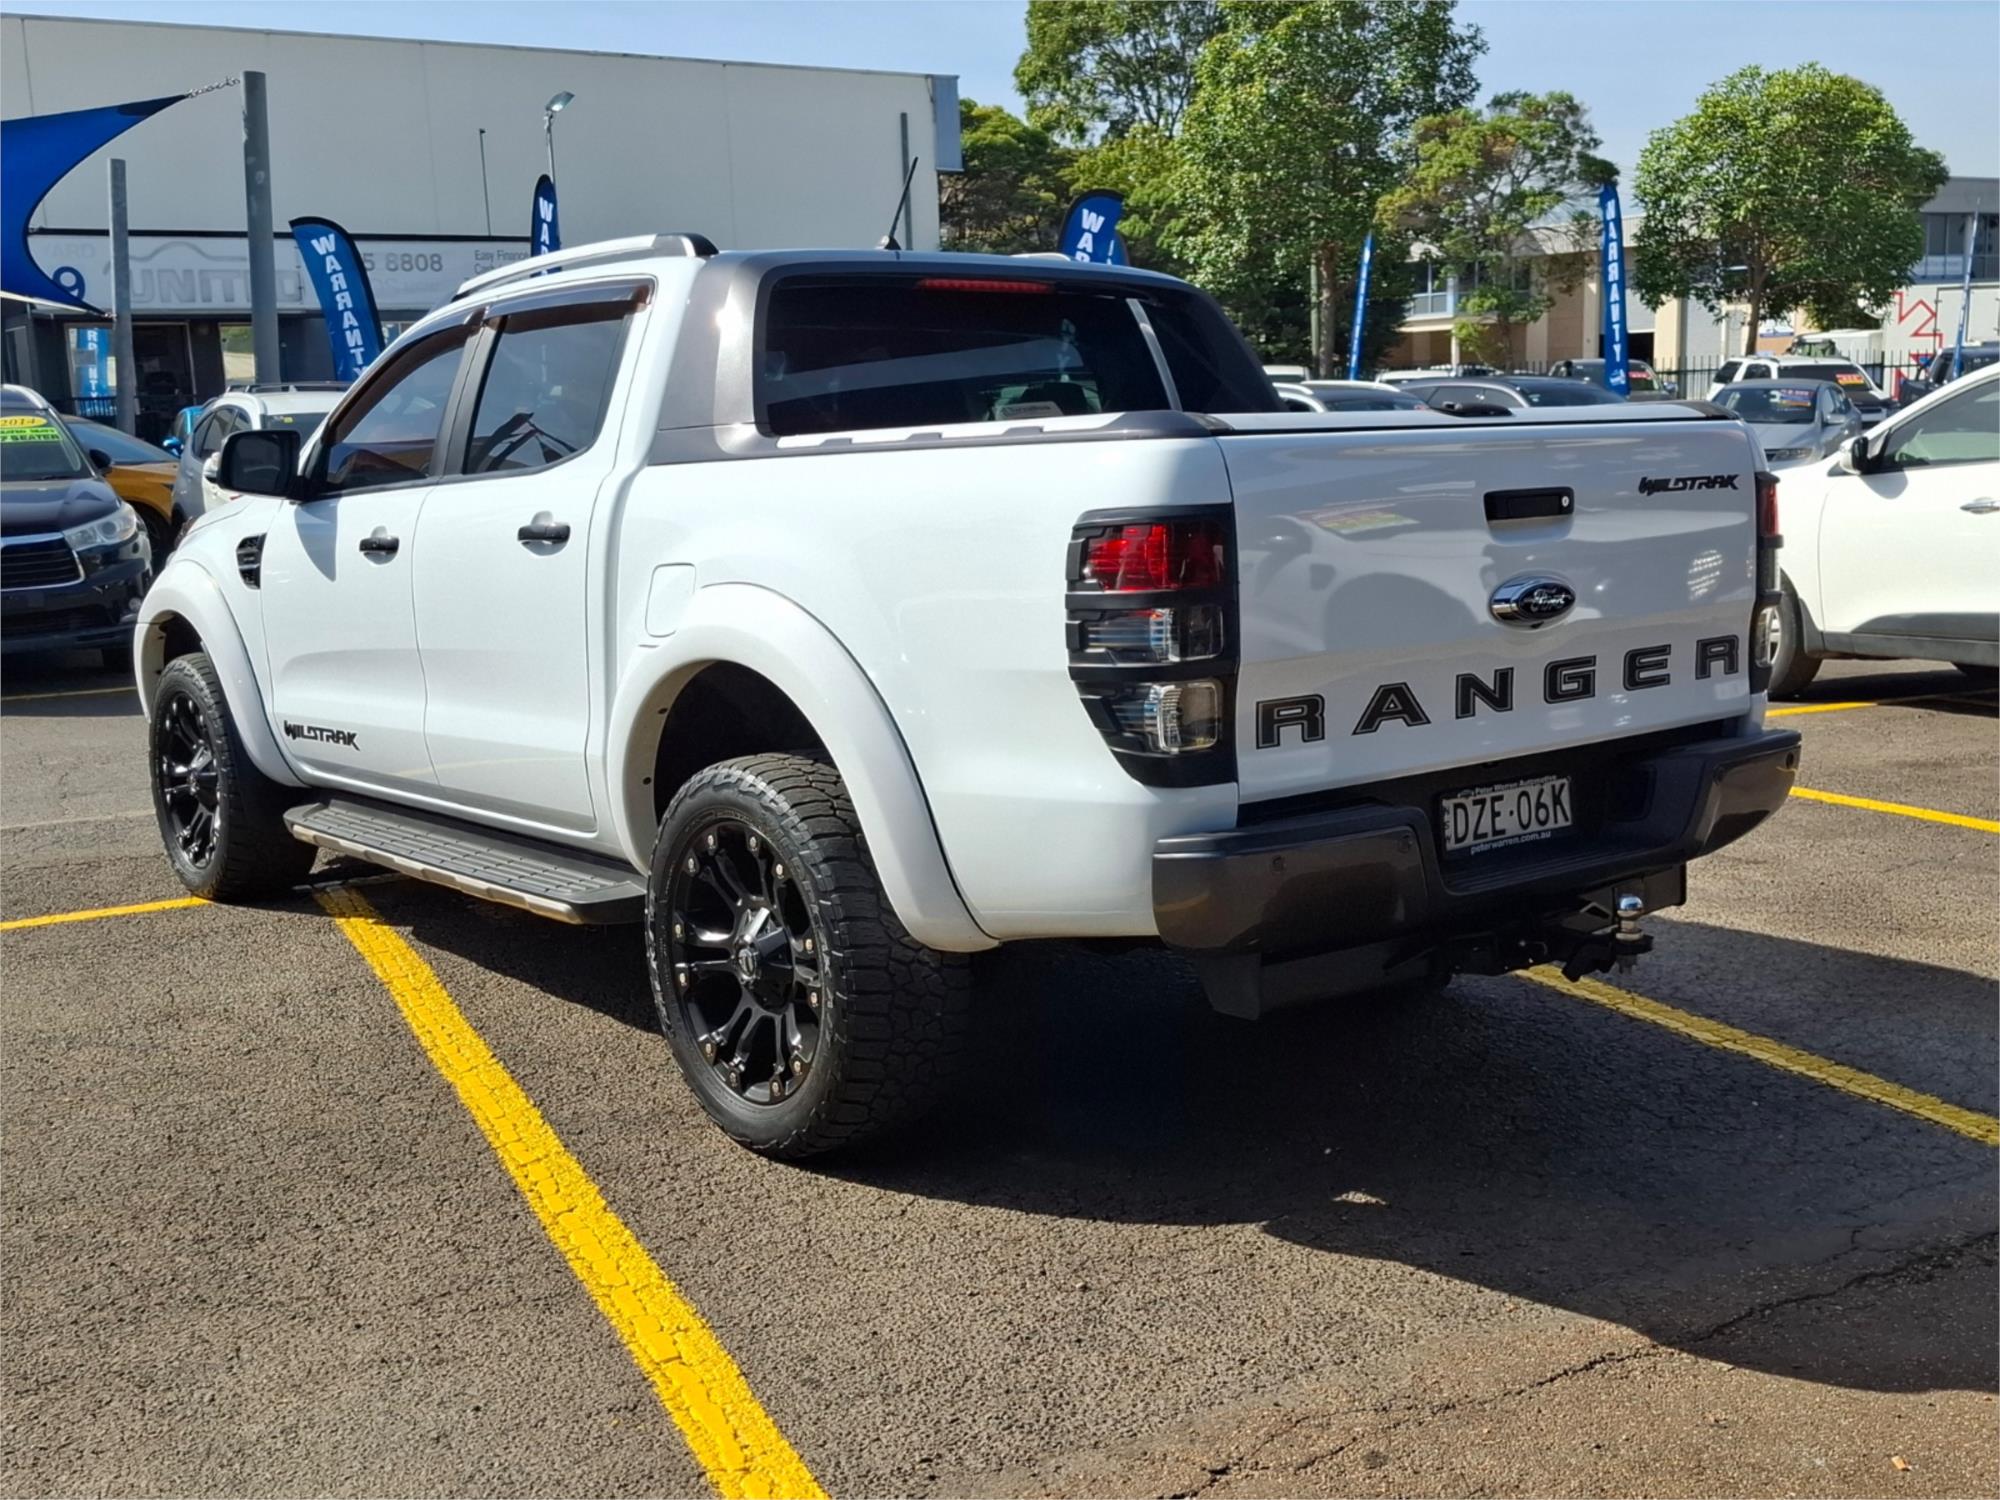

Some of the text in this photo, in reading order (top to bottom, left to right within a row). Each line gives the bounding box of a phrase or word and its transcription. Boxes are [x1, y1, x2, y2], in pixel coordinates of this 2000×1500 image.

[385, 253, 443, 272] 8808
[128, 269, 303, 303] UNITD
[1638, 474, 1739, 496] WILDTRAK
[1256, 634, 1739, 749] RANGER
[284, 720, 360, 751] WILDTRAK
